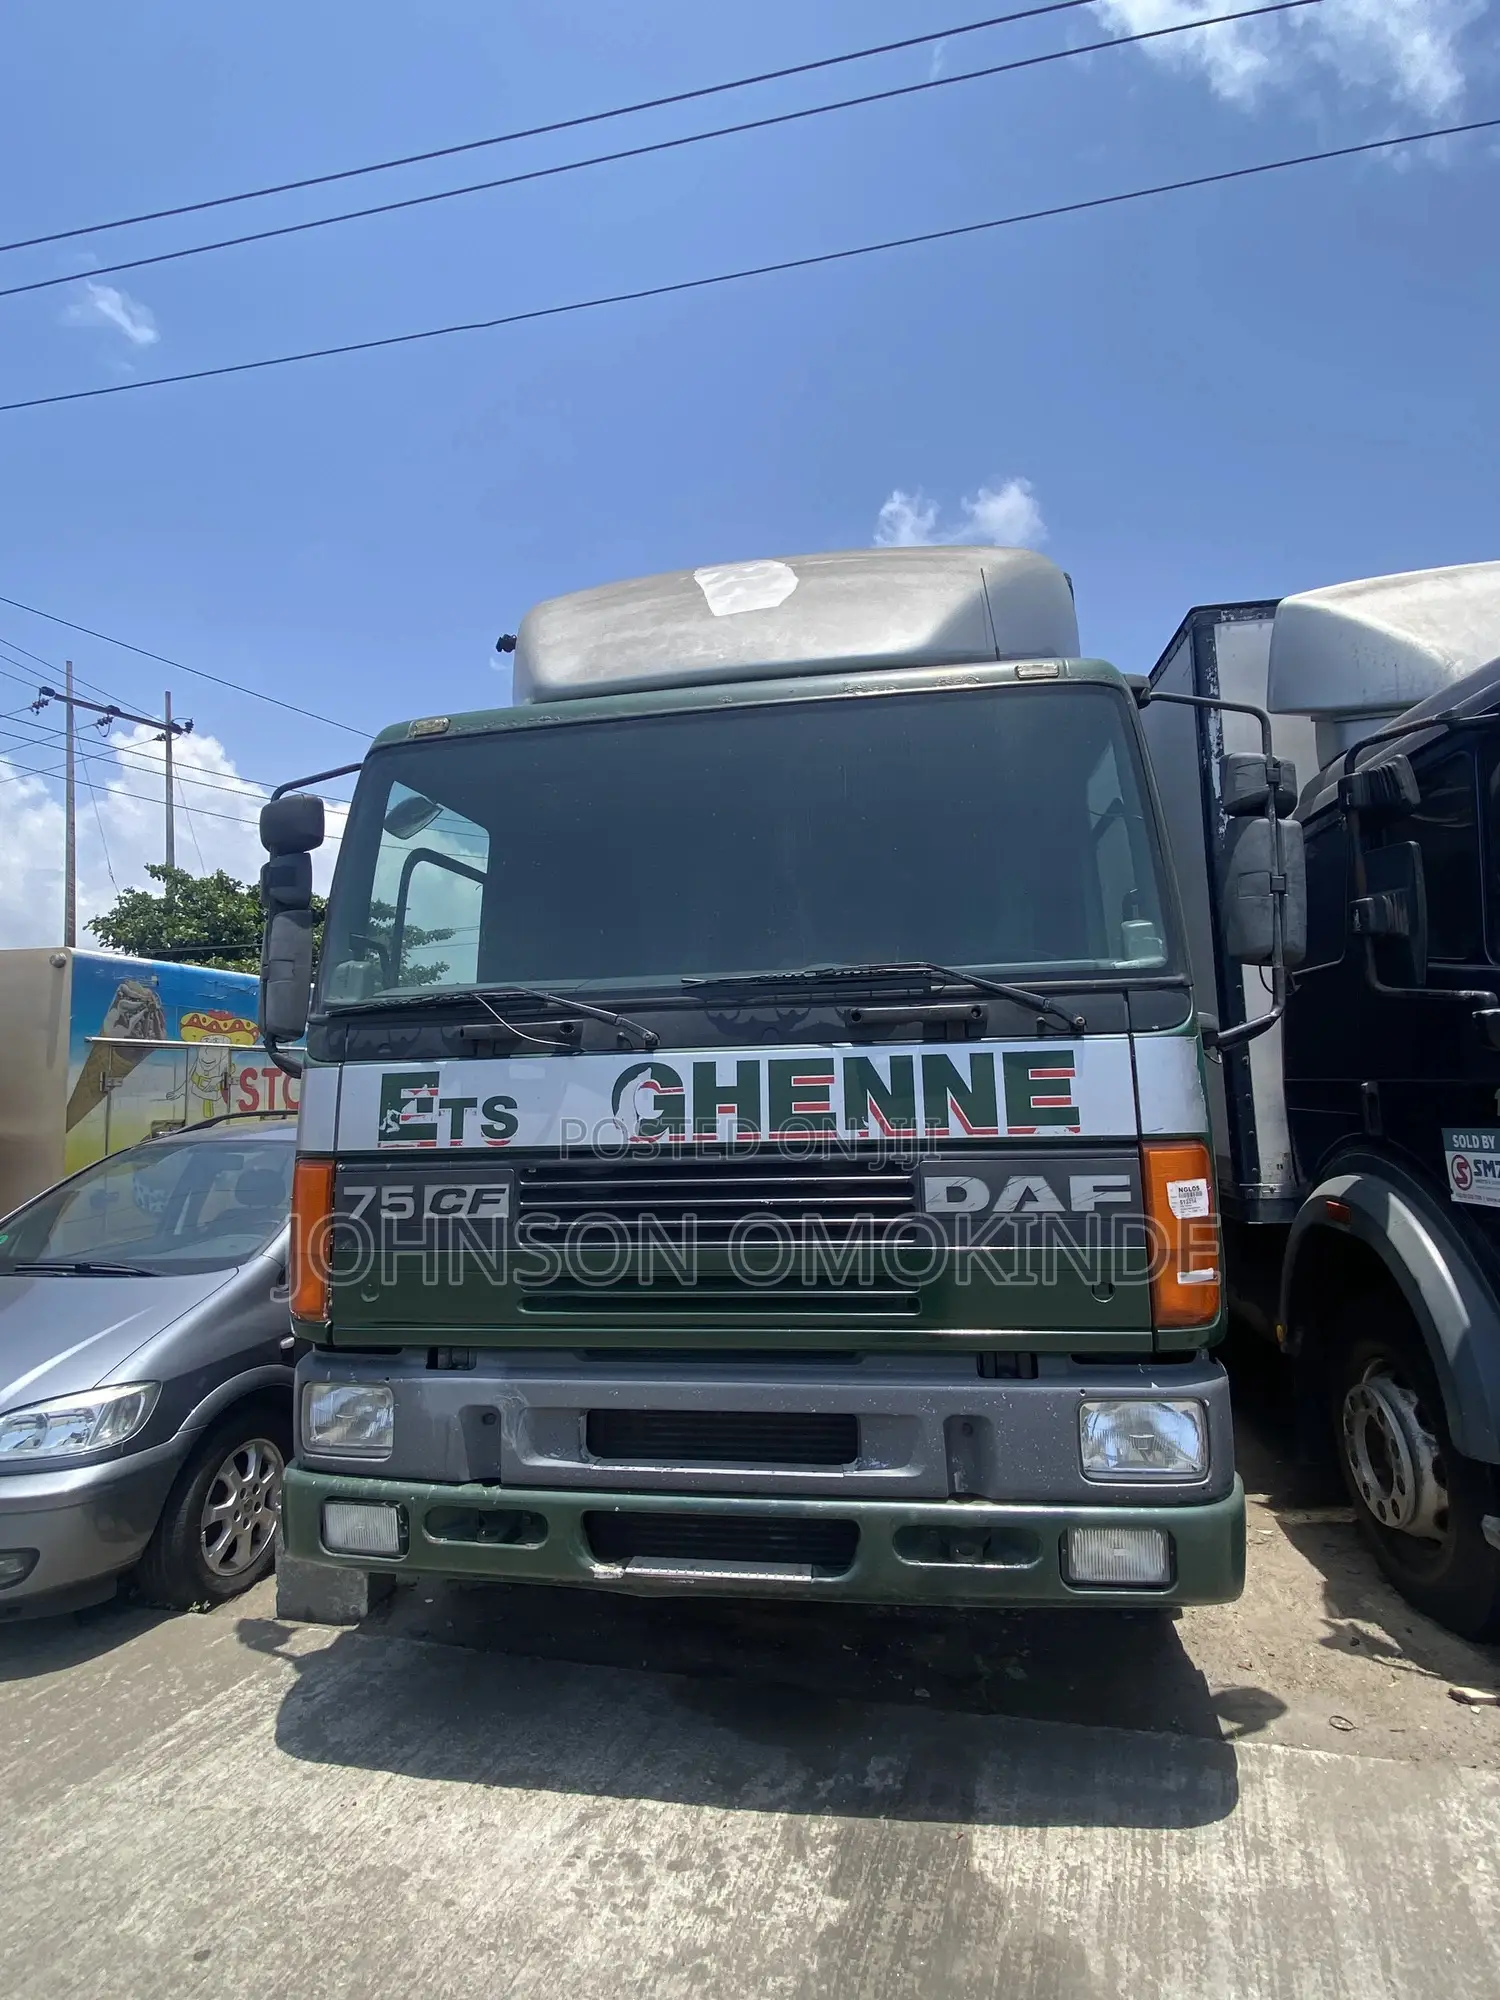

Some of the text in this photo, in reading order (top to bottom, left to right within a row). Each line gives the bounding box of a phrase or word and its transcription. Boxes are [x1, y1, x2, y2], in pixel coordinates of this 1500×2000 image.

[611, 1050, 1081, 1143] GHENNE
[1452, 1134, 1496, 1150] SOLD BY
[343, 1185, 508, 1220] 75 CF
[924, 1175, 1133, 1214] DAF
